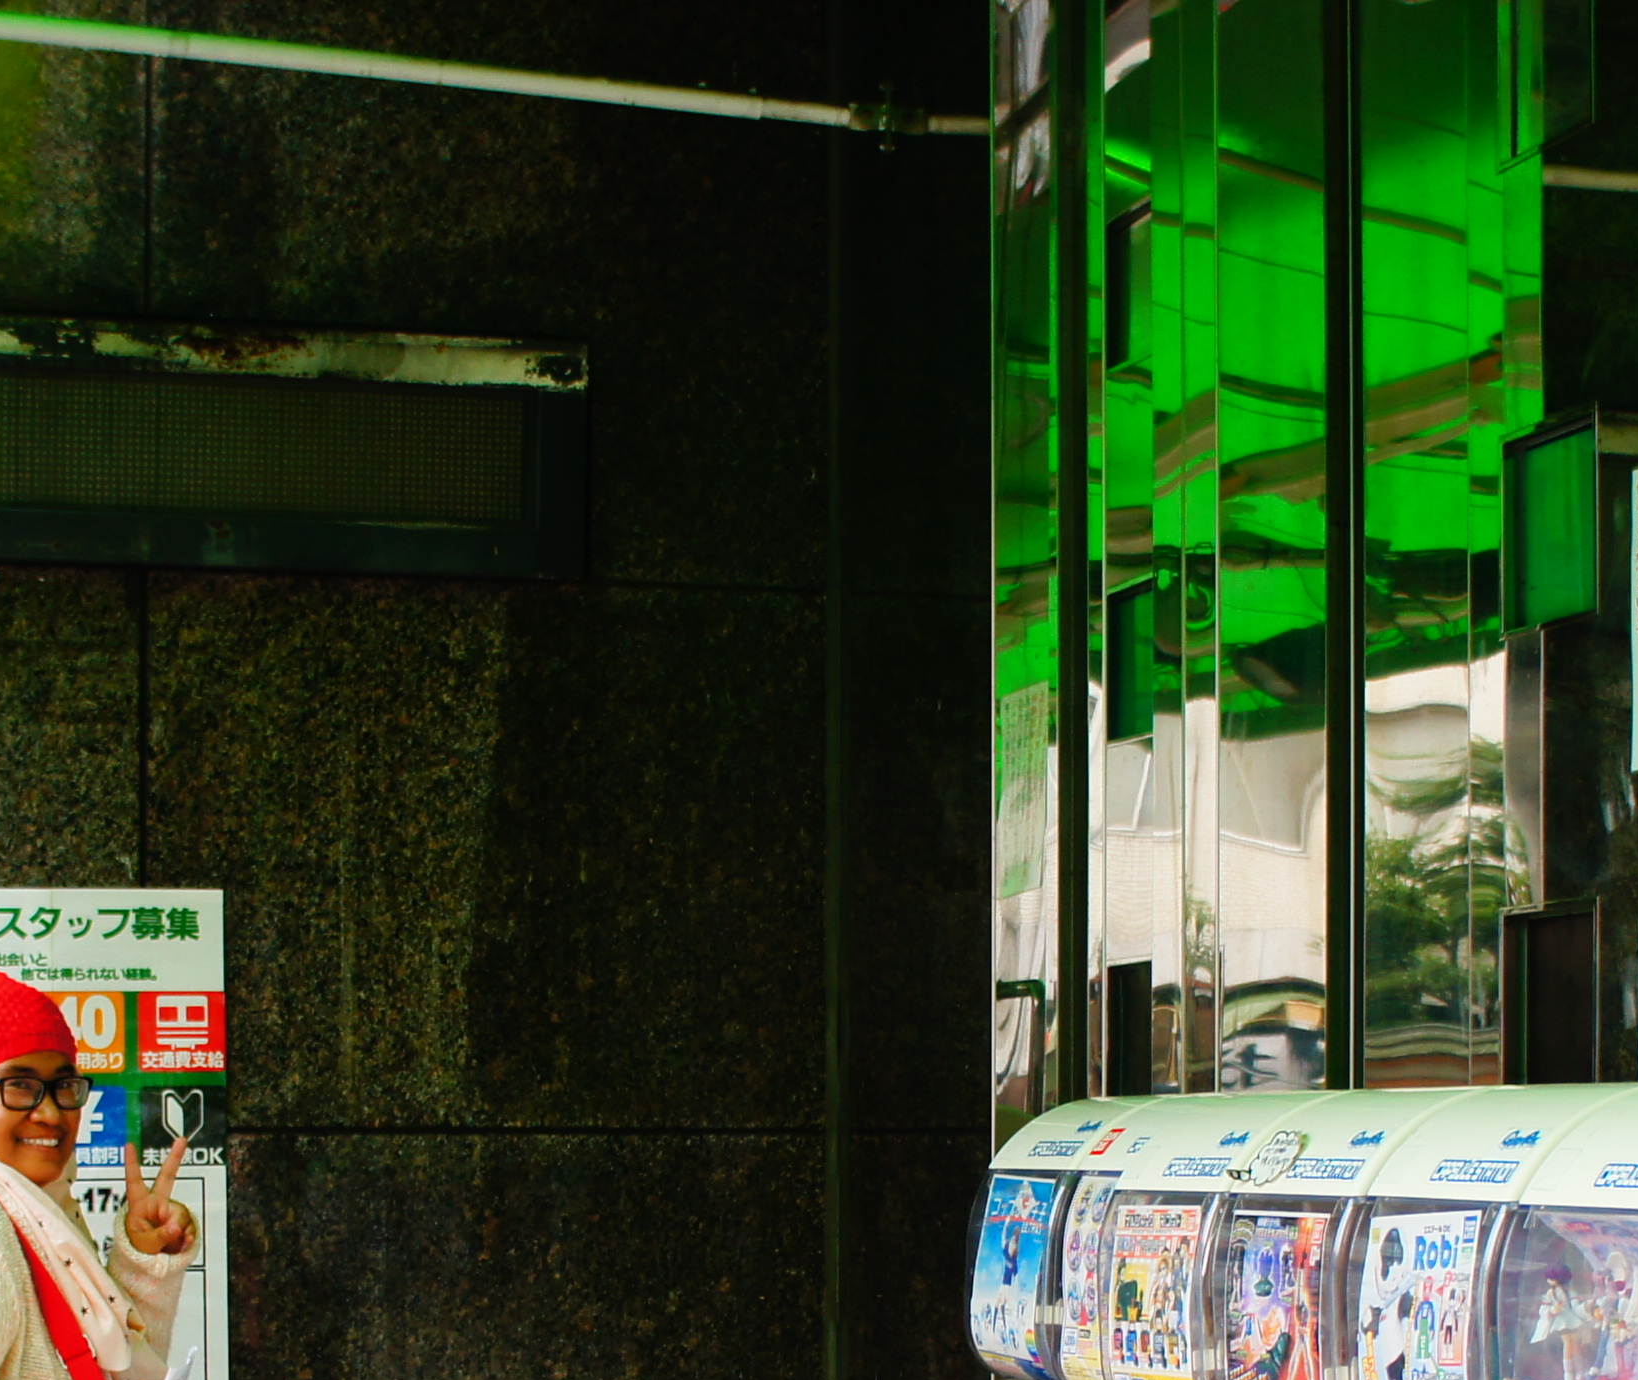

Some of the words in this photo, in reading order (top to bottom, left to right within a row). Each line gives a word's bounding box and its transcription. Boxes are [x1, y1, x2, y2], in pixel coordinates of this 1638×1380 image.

[20, 966, 160, 983] 他では得られない経験。
[141, 1051, 225, 1070] 交通費支給
[1413, 1234, 1461, 1272] Robi
